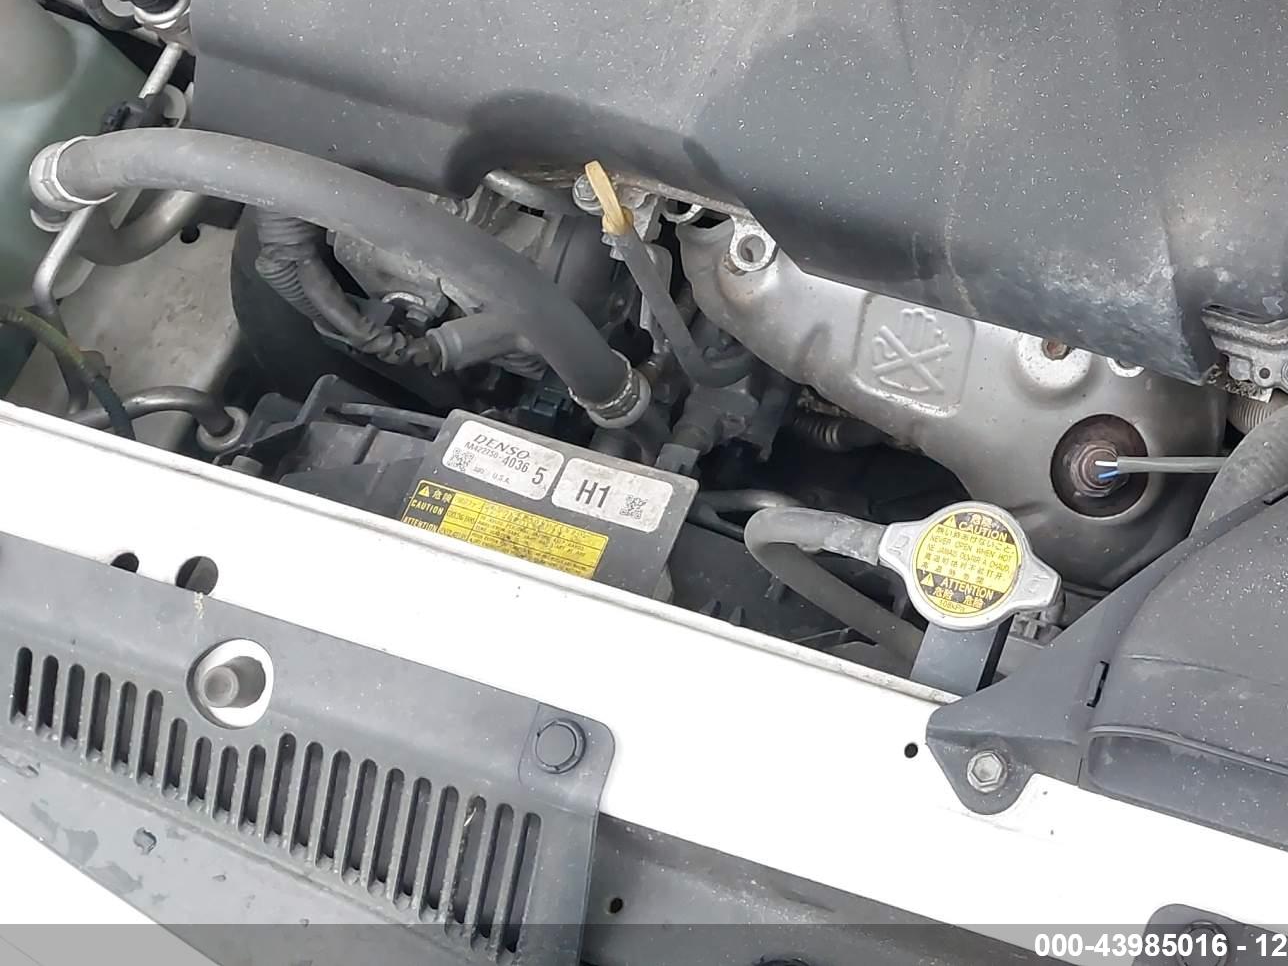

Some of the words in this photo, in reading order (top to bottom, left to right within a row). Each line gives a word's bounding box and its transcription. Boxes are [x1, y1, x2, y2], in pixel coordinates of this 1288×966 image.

[473, 433, 530, 460] DENSO
[531, 467, 547, 486] 5
[575, 479, 611, 509] H1
[411, 499, 444, 515] CAUTION
[959, 521, 1008, 540] CAUTION
[940, 578, 994, 600] ATTENTION
